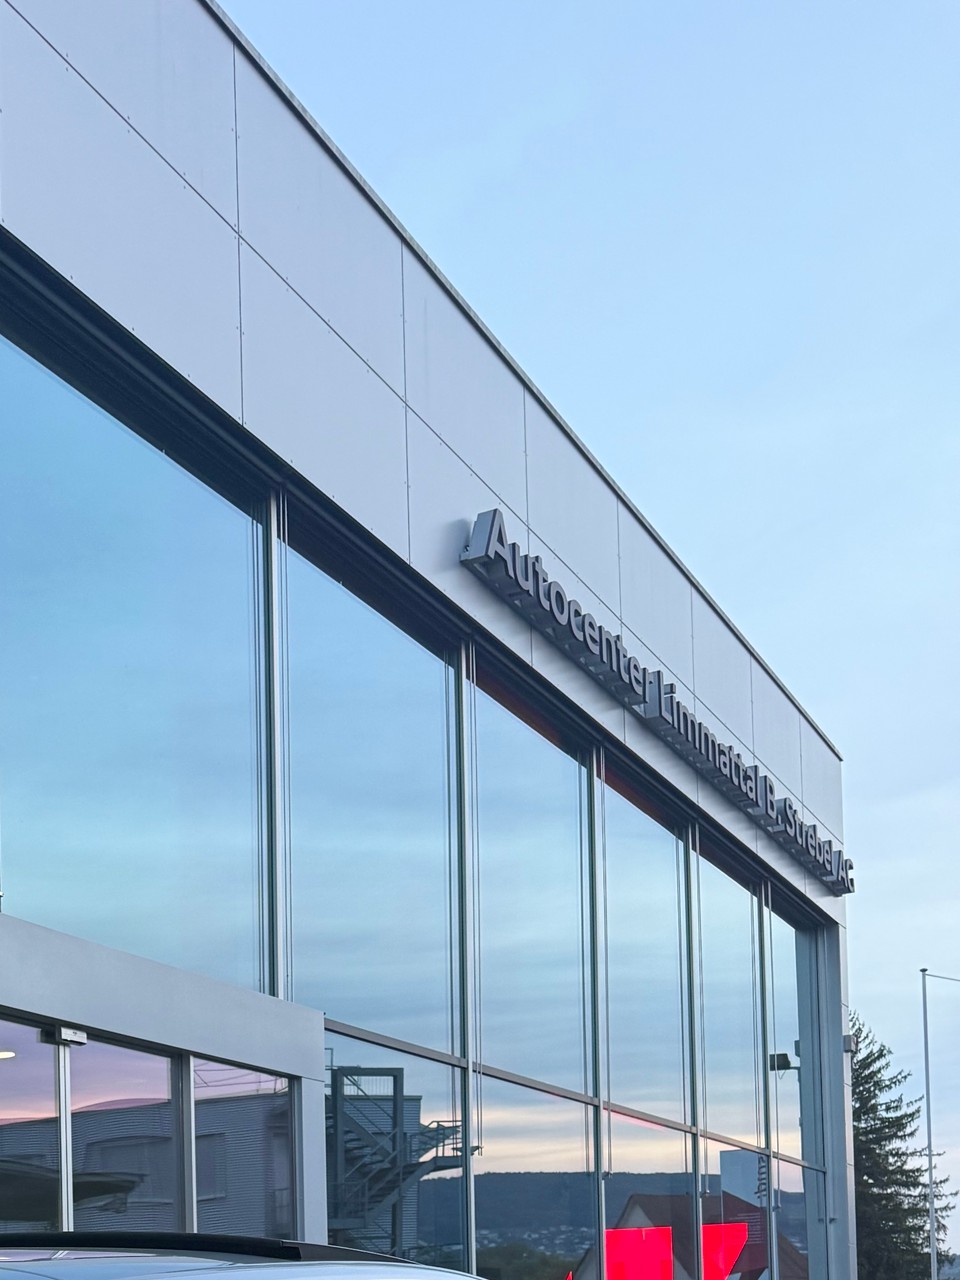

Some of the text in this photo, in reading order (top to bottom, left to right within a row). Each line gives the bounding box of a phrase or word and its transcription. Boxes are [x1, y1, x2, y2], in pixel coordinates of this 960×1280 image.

[486, 508, 654, 703] Autocenter
[658, 670, 762, 808] Limmattal
[765, 775, 782, 825] B.
[785, 797, 836, 876] Strebel
